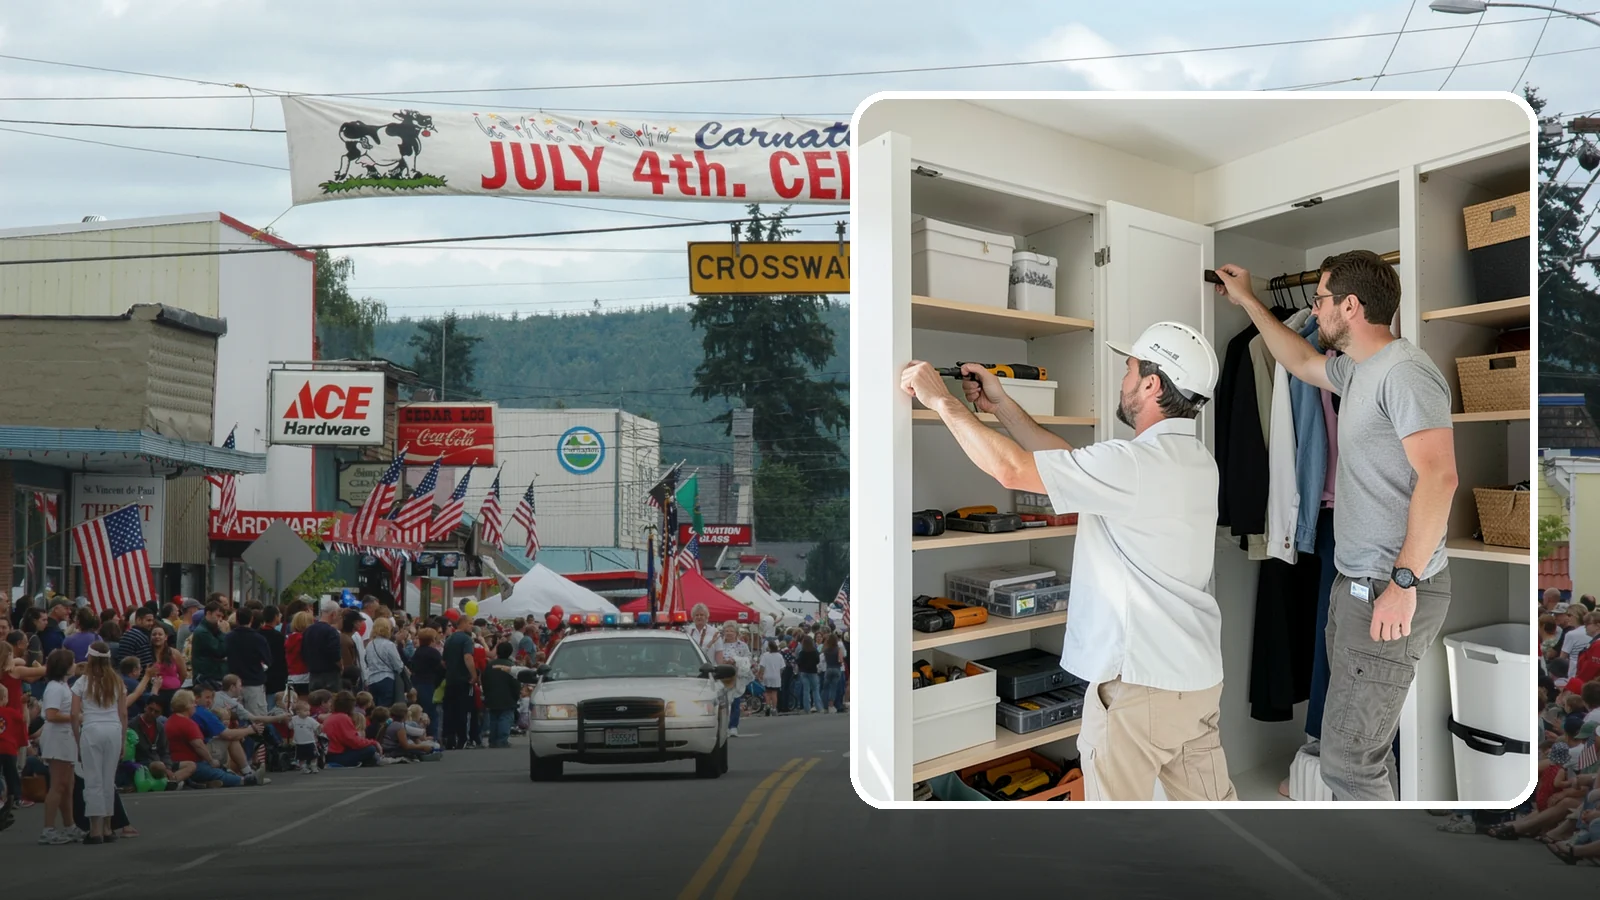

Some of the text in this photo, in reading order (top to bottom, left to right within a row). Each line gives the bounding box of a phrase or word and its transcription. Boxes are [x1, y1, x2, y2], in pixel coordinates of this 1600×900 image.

[481, 140, 605, 193] JULY
[632, 150, 746, 197] 4th.
[697, 254, 850, 280] CROSSWA
[282, 380, 373, 420] ACE
[405, 409, 452, 422] CEDAR
[283, 421, 371, 436] Hardware
[416, 427, 477, 447] Coca-Cola
[96, 484, 124, 495] Vincent
[126, 485, 136, 495] de
[137, 485, 155, 495] Paul
[688, 526, 741, 535] CRNATION
[699, 535, 730, 544] GLASS
